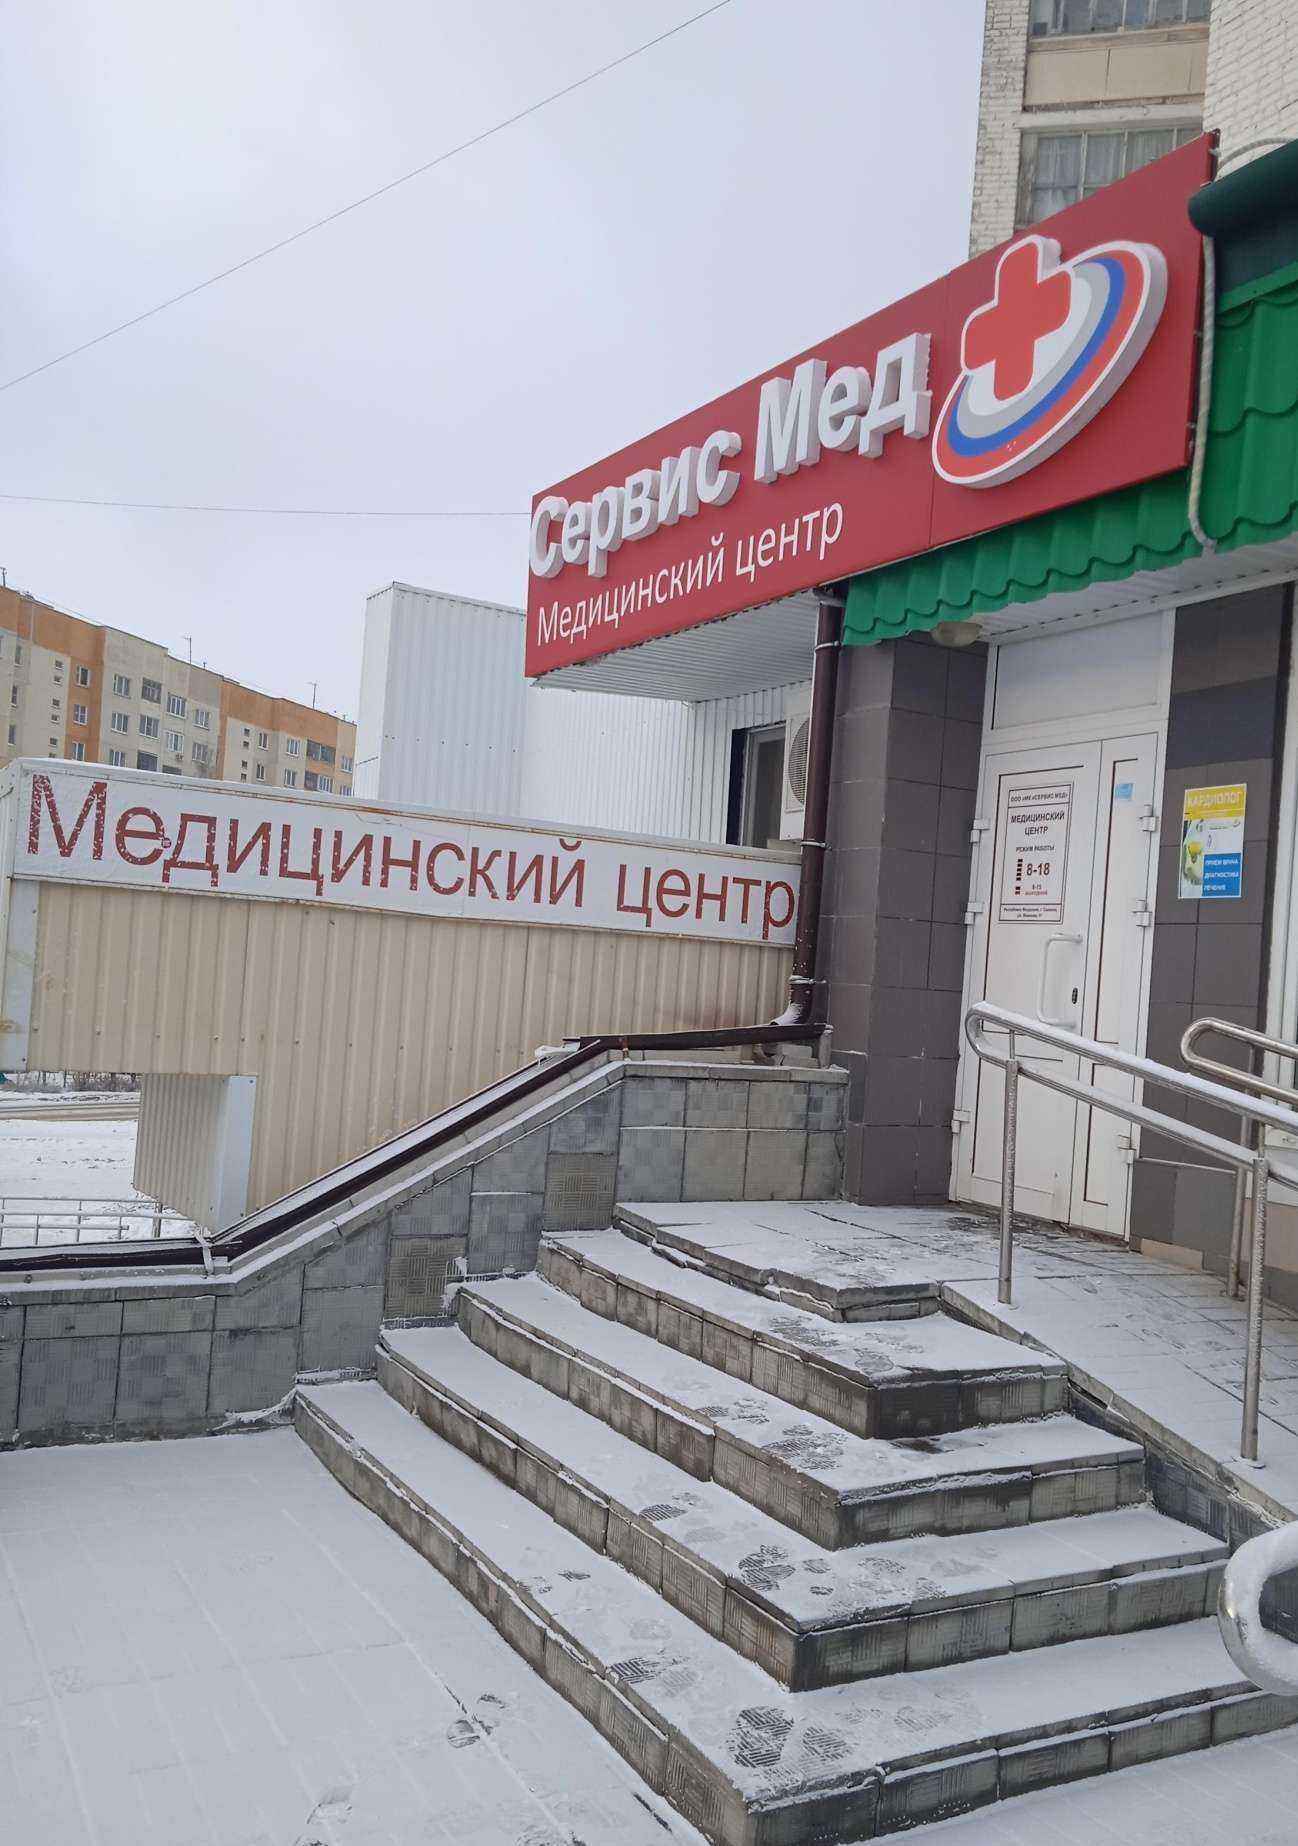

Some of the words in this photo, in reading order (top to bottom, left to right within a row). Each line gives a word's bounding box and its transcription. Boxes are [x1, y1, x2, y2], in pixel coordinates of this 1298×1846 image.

[530, 430, 742, 578] Сервис
[754, 332, 932, 483] Мед
[538, 533, 727, 646] Медицинский
[736, 502, 844, 581] центр
[1010, 810, 1065, 823] МЕДИЦИНСКИЙ
[1024, 826, 1049, 836] ЦЕНТР
[27, 774, 585, 907] Медицинский
[616, 863, 796, 941] центр
[1026, 862, 1050, 876] 8-18
